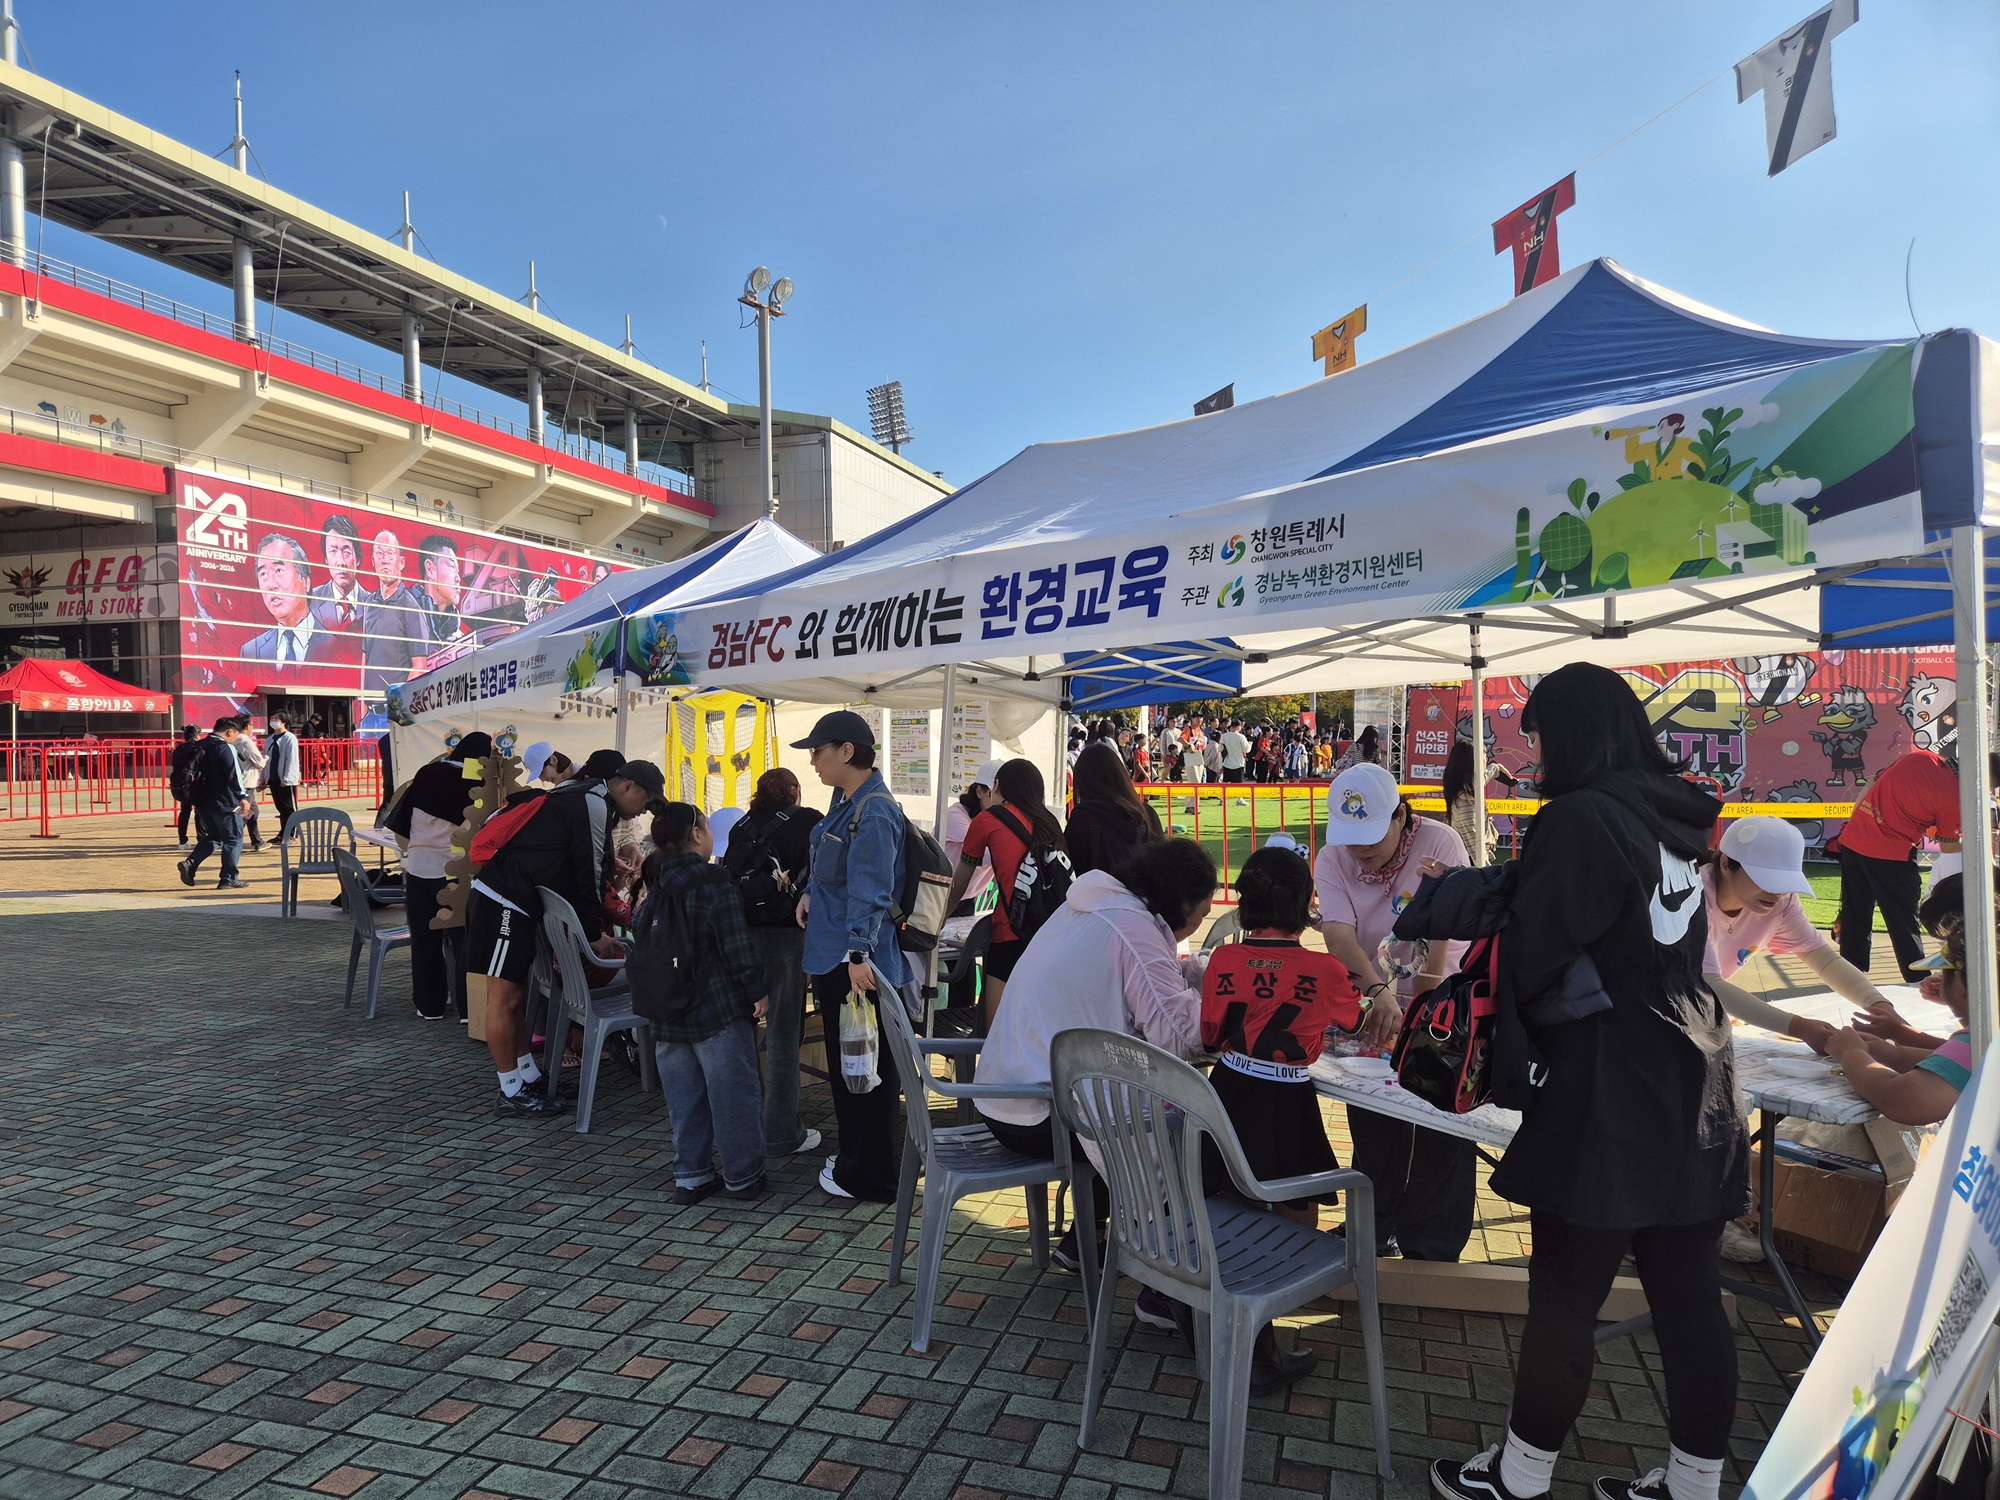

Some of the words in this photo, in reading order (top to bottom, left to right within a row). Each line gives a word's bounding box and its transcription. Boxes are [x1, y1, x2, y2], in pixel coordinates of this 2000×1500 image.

[1523, 232, 1545, 252] NH
[1333, 348, 1347, 363] NH
[1250, 513, 1345, 553] 창원특례시
[186, 547, 248, 564] ANNIVERSARY
[1188, 542, 1214, 566] 주최
[1251, 551, 1290, 564] CHANGWON
[1290, 545, 1317, 557] SPECIAL
[1318, 543, 1334, 553] CITY
[65, 555, 143, 595] GFC
[200, 561, 235, 572] 2006-2026
[1254, 548, 1424, 595] 경남녹색환경지원센터
[1181, 584, 1210, 607] 주관
[1259, 593, 1302, 604] Gyeongnam
[1304, 589, 1327, 599] Green
[1329, 583, 1379, 596] Environment
[1380, 578, 1410, 590] Center
[8, 601, 49, 613] GYEONGNAM
[56, 600, 94, 617] MEGA
[100, 597, 145, 615] STORE
[707, 616, 793, 669] 경남FC
[794, 609, 828, 660] 와
[833, 587, 965, 657] 함께하는
[979, 545, 1170, 640] 환경교육
[480, 659, 518, 700] 환경교육
[1755, 667, 1800, 682] GYEONGNAM
[66, 697, 133, 711] 종합안내소
[1415, 730, 1449, 743] 선수단
[1414, 743, 1448, 756] 사인회
[1512, 802, 1528, 812] AREA
[1736, 806, 1754, 815] AREA
[1824, 805, 1853, 815] SECURIT
[1219, 1001, 1308, 1064] 16
[1231, 1055, 1252, 1071] LOVE
[1275, 1066, 1301, 1079] LOVE
